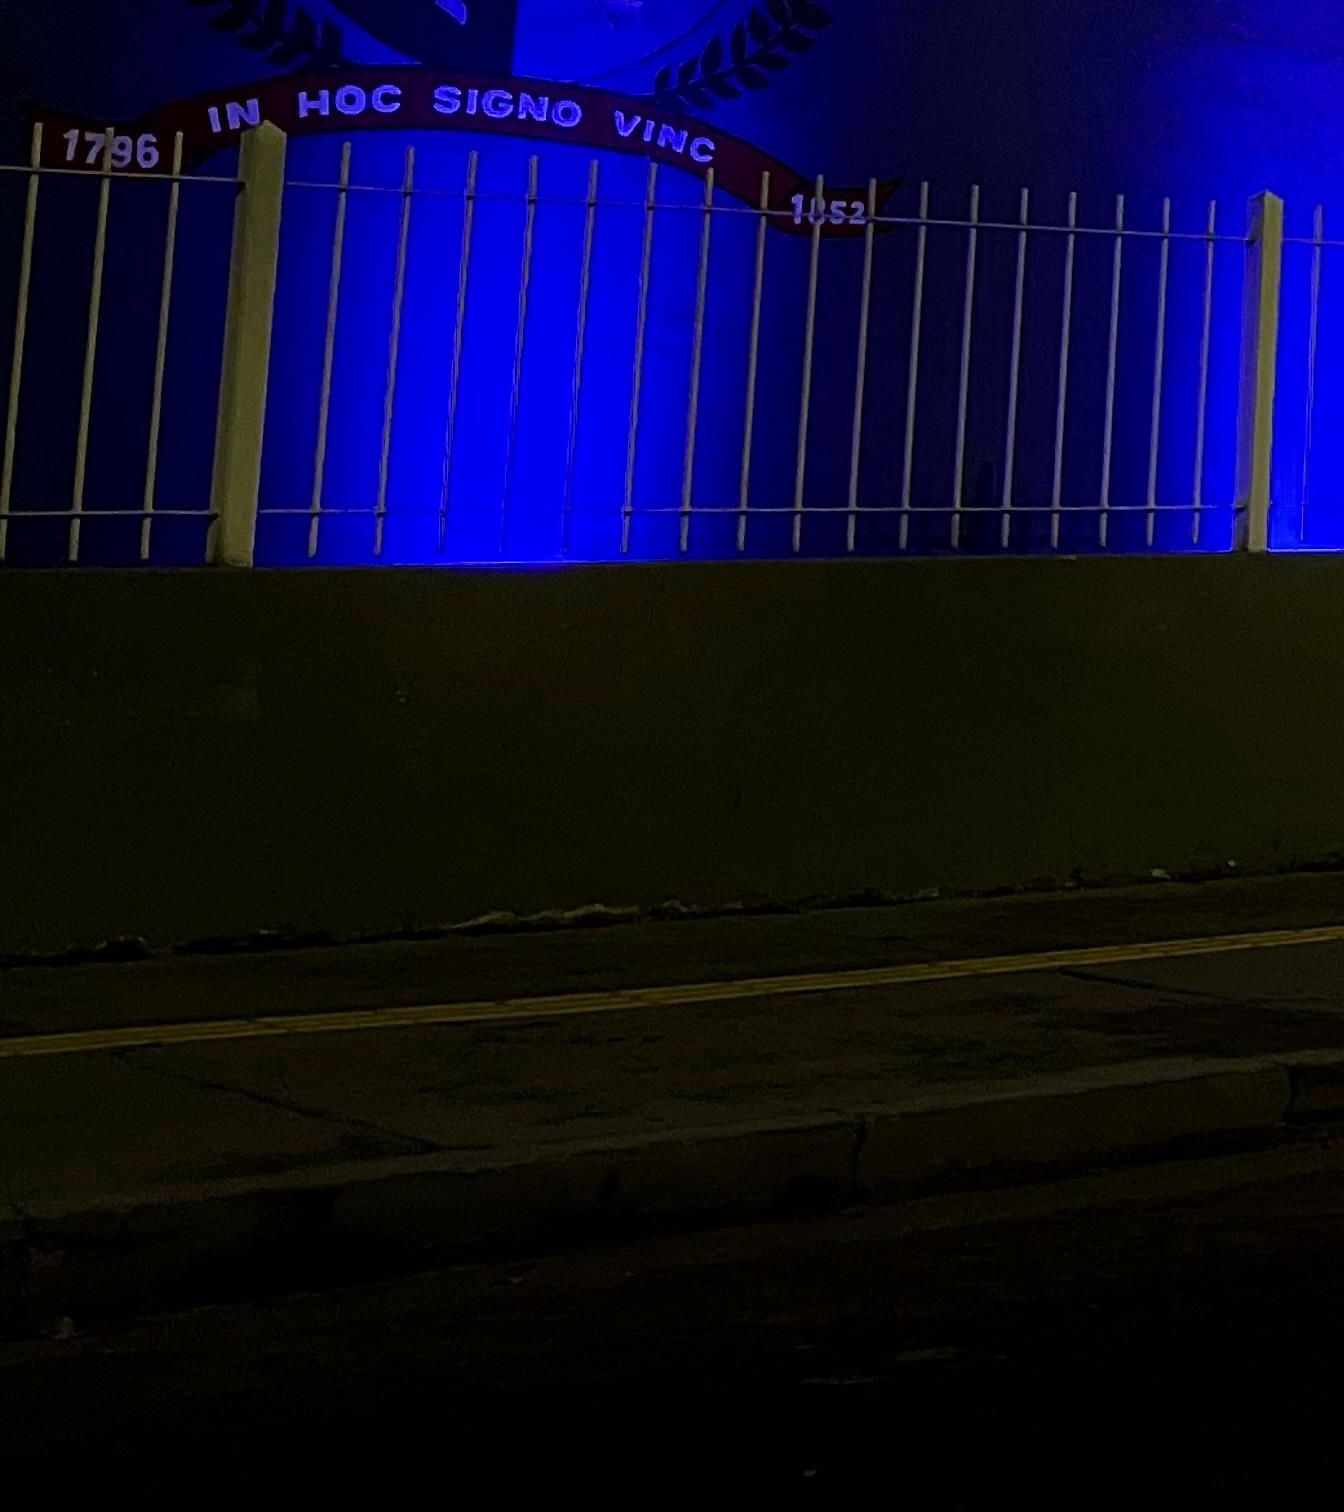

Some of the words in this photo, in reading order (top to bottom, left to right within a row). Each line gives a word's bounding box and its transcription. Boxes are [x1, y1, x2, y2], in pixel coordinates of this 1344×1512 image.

[62, 127, 160, 169] 1796
[207, 97, 261, 134] IN
[297, 84, 402, 119] HOC
[432, 85, 583, 128] SIGNO
[613, 110, 717, 164] VINC
